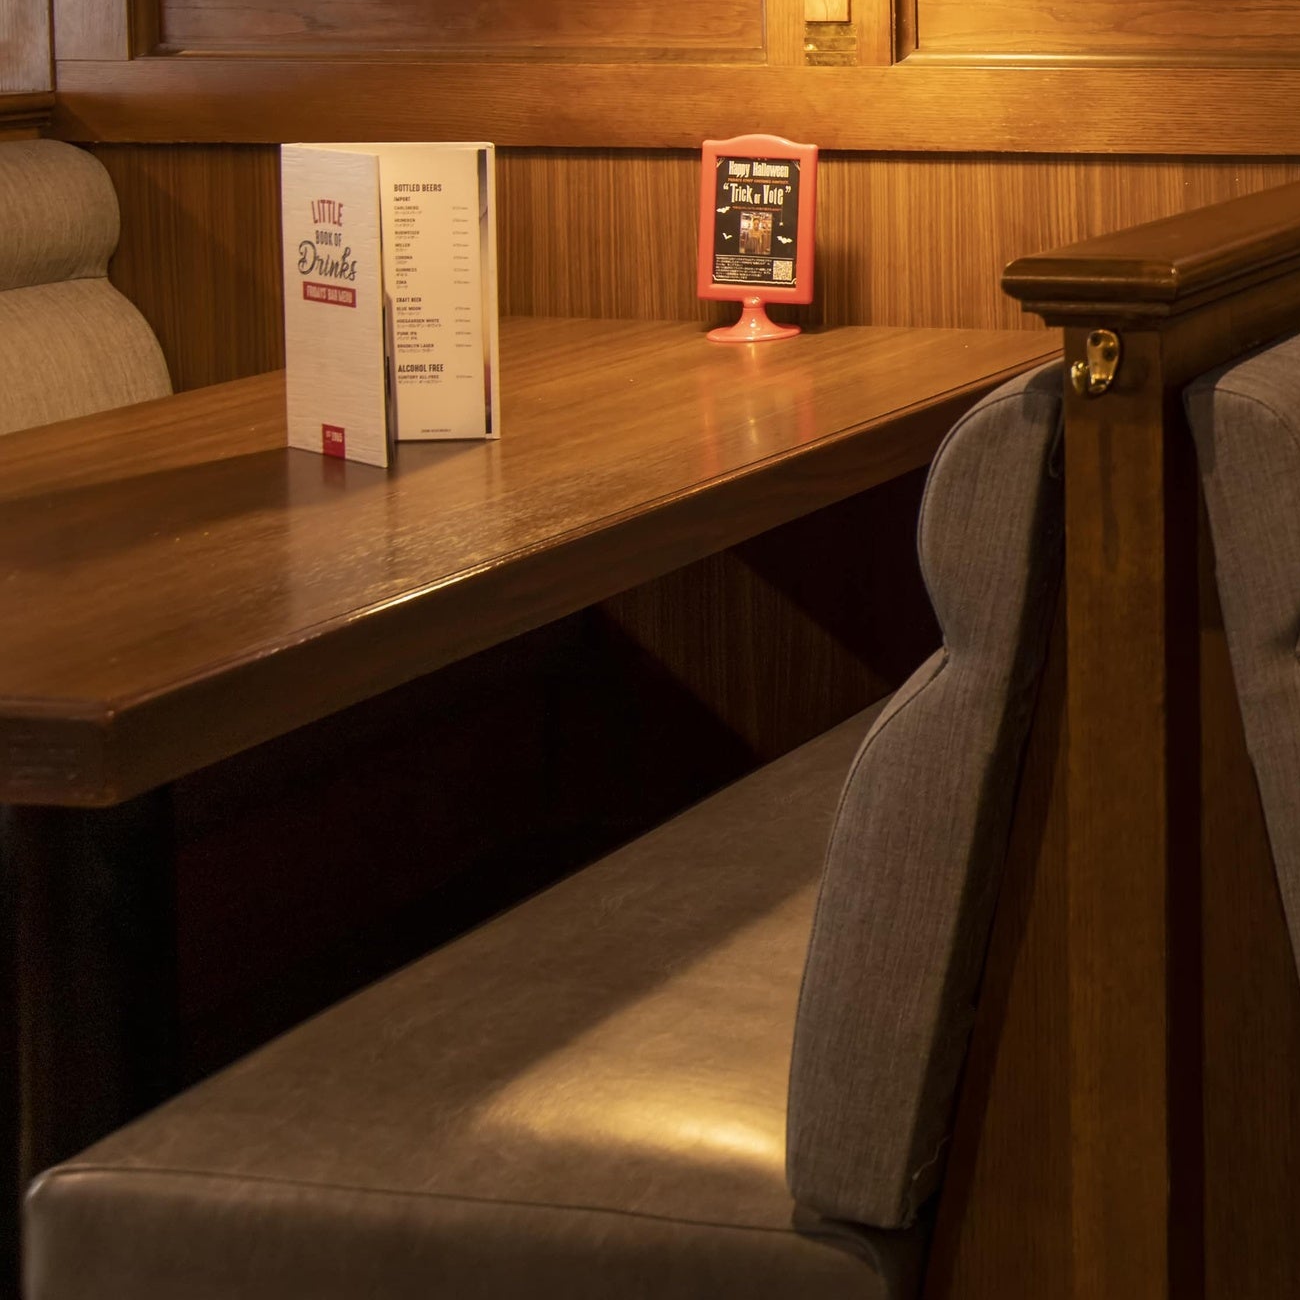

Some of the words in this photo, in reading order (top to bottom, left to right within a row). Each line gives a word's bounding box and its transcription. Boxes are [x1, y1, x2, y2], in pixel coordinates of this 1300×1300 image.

[729, 161, 750, 178] Happy
[753, 162, 789, 178] Halloween
[394, 184, 420, 192] BOTTLED
[422, 184, 442, 192] BEERS
[754, 194, 760, 204] or
[311, 199, 344, 227] LITTLE
[315, 230, 333, 247] BOOK
[334, 232, 342, 247] OF
[298, 240, 358, 281] Drinks
[398, 364, 427, 372] ALCOHOL
[429, 364, 444, 372] FREE
